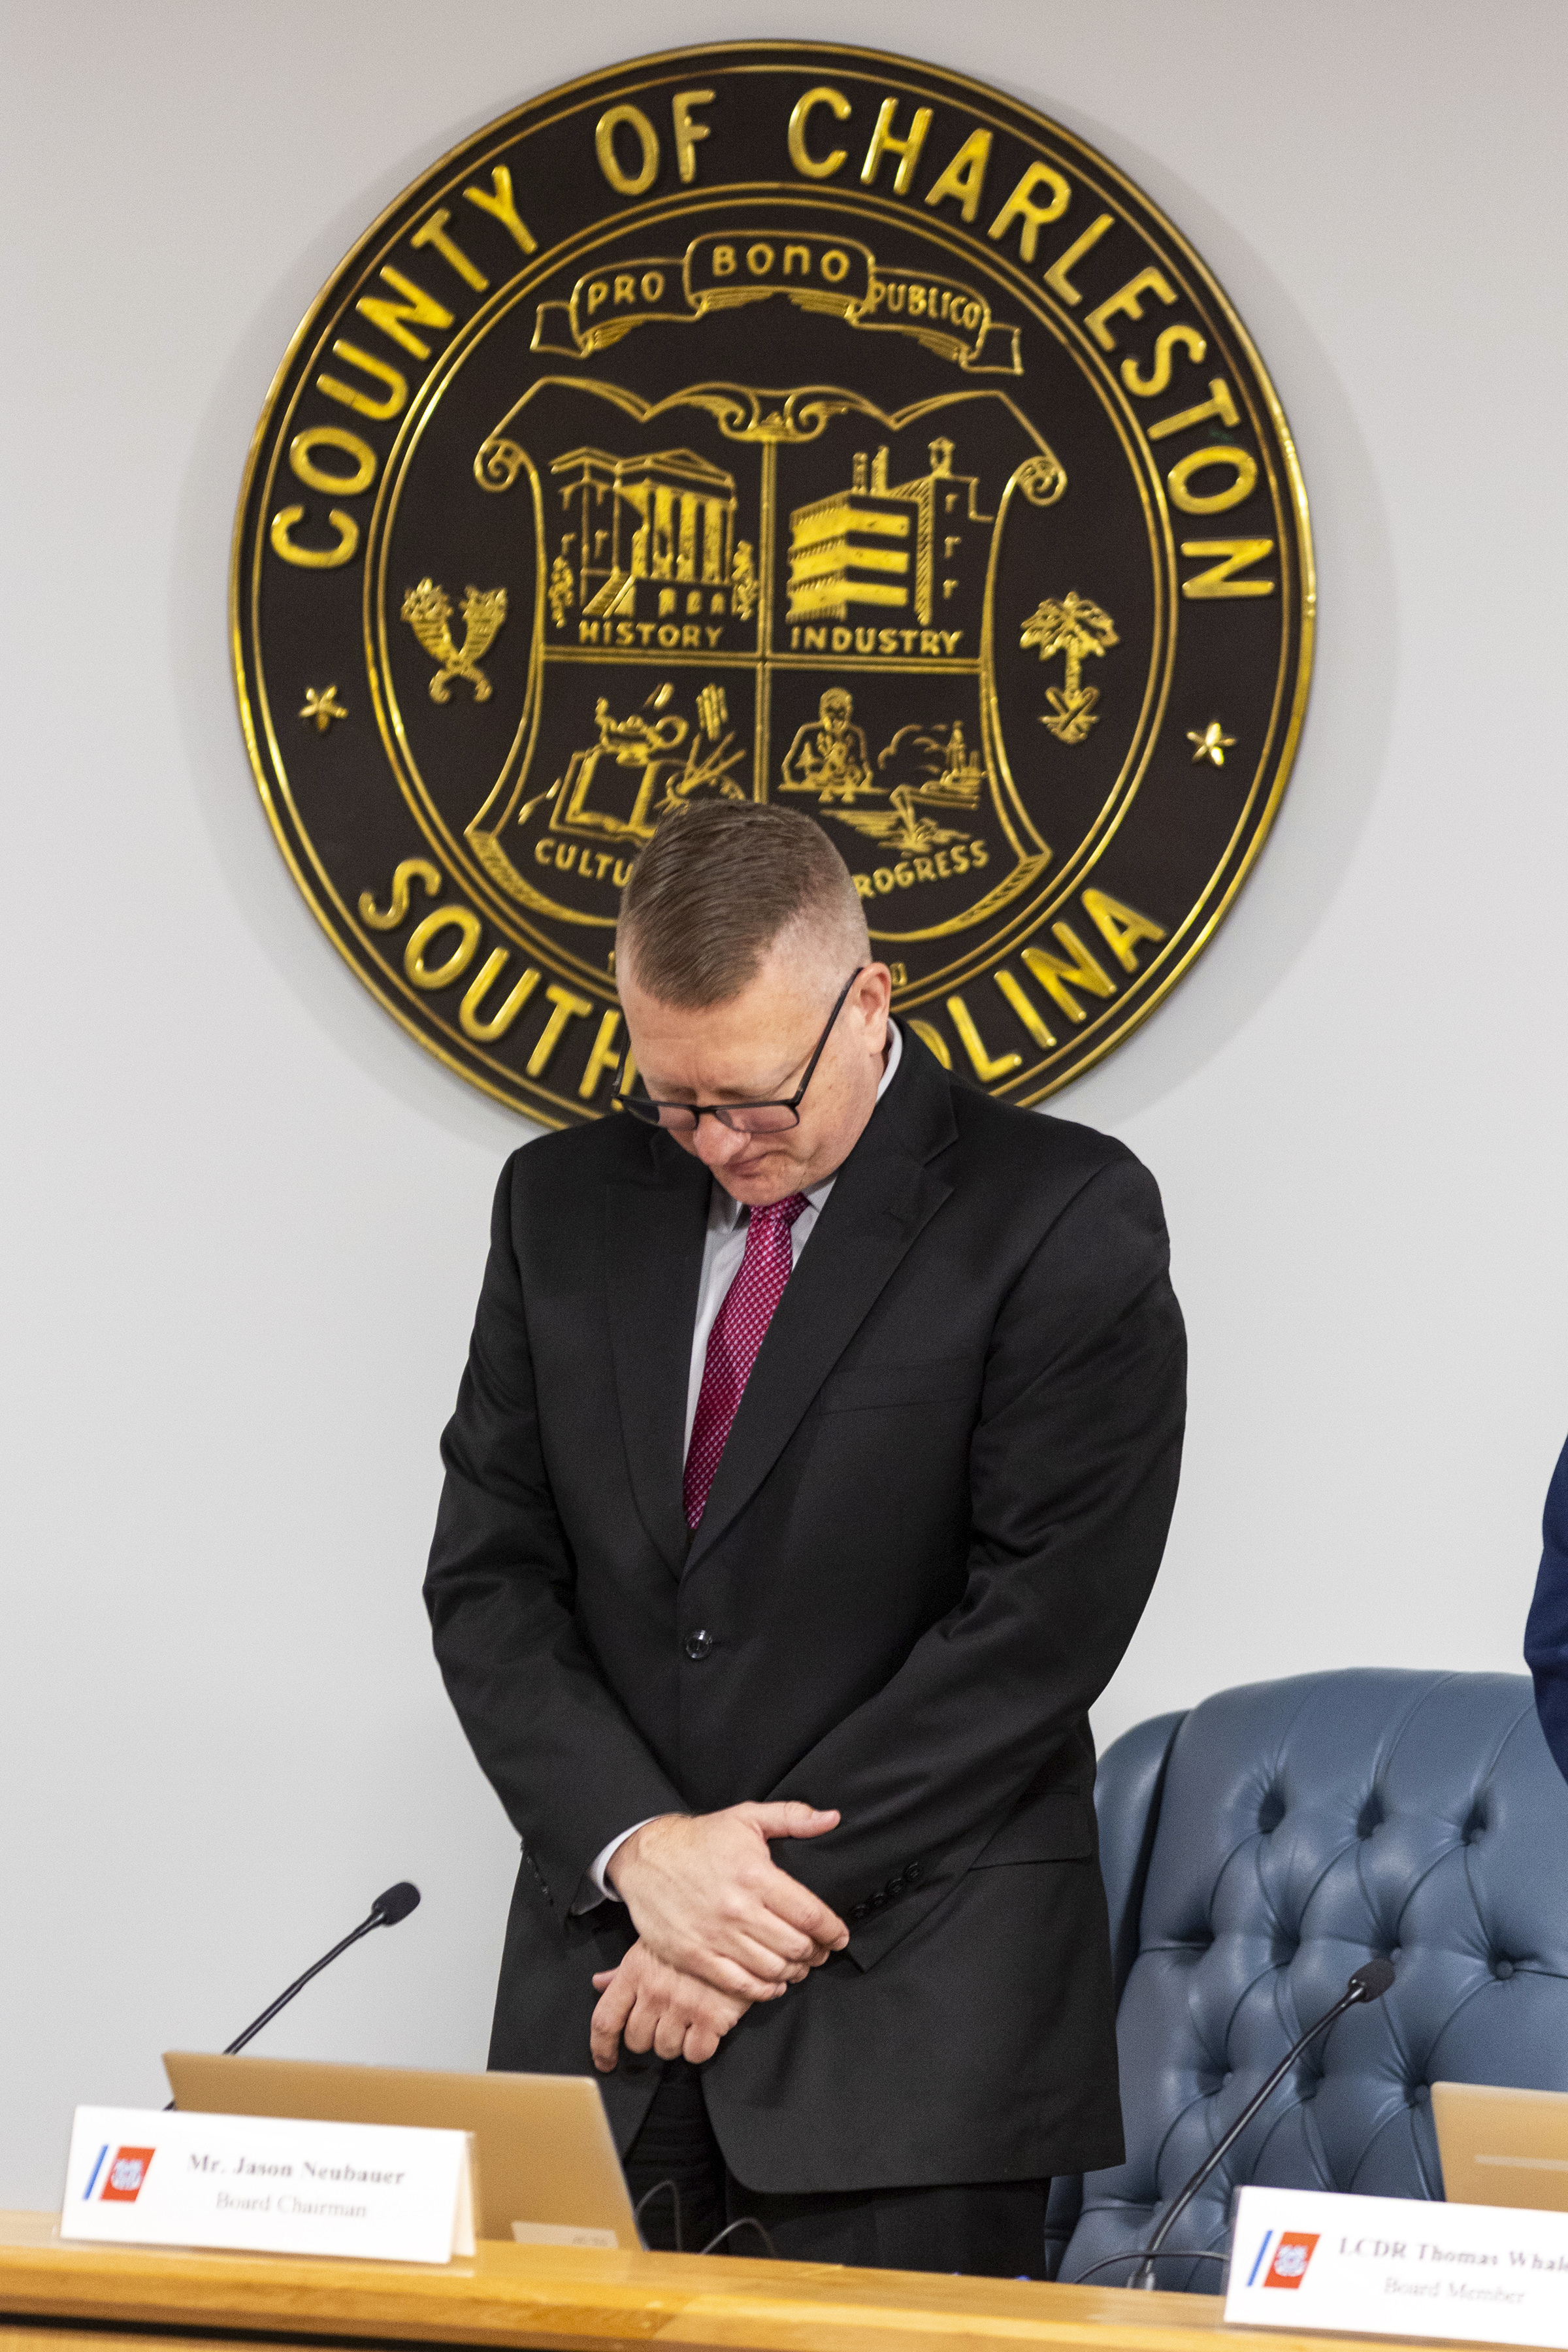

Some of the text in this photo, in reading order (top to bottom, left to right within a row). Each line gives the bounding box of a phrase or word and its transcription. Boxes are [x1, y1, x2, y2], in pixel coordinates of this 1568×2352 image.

[587, 271, 664, 315] PRO
[867, 281, 981, 330] PUBLICO
[270, 86, 1275, 600] COUNTY OF CHARLESTON
[578, 619, 723, 648] HISTORY
[790, 625, 964, 656] INDUSTRY
[534, 837, 634, 888] CULTU
[851, 839, 990, 899] ROGRESS
[358, 858, 1168, 1111] SOUTH LINA
[187, 2153, 406, 2185] Mr. Jason Neubauer
[215, 2190, 368, 2219] Board Chairman
[1339, 2235, 1408, 2260] LCDR
[1415, 2241, 1499, 2267] Thomas
[1383, 2276, 1526, 2305] Board Member
